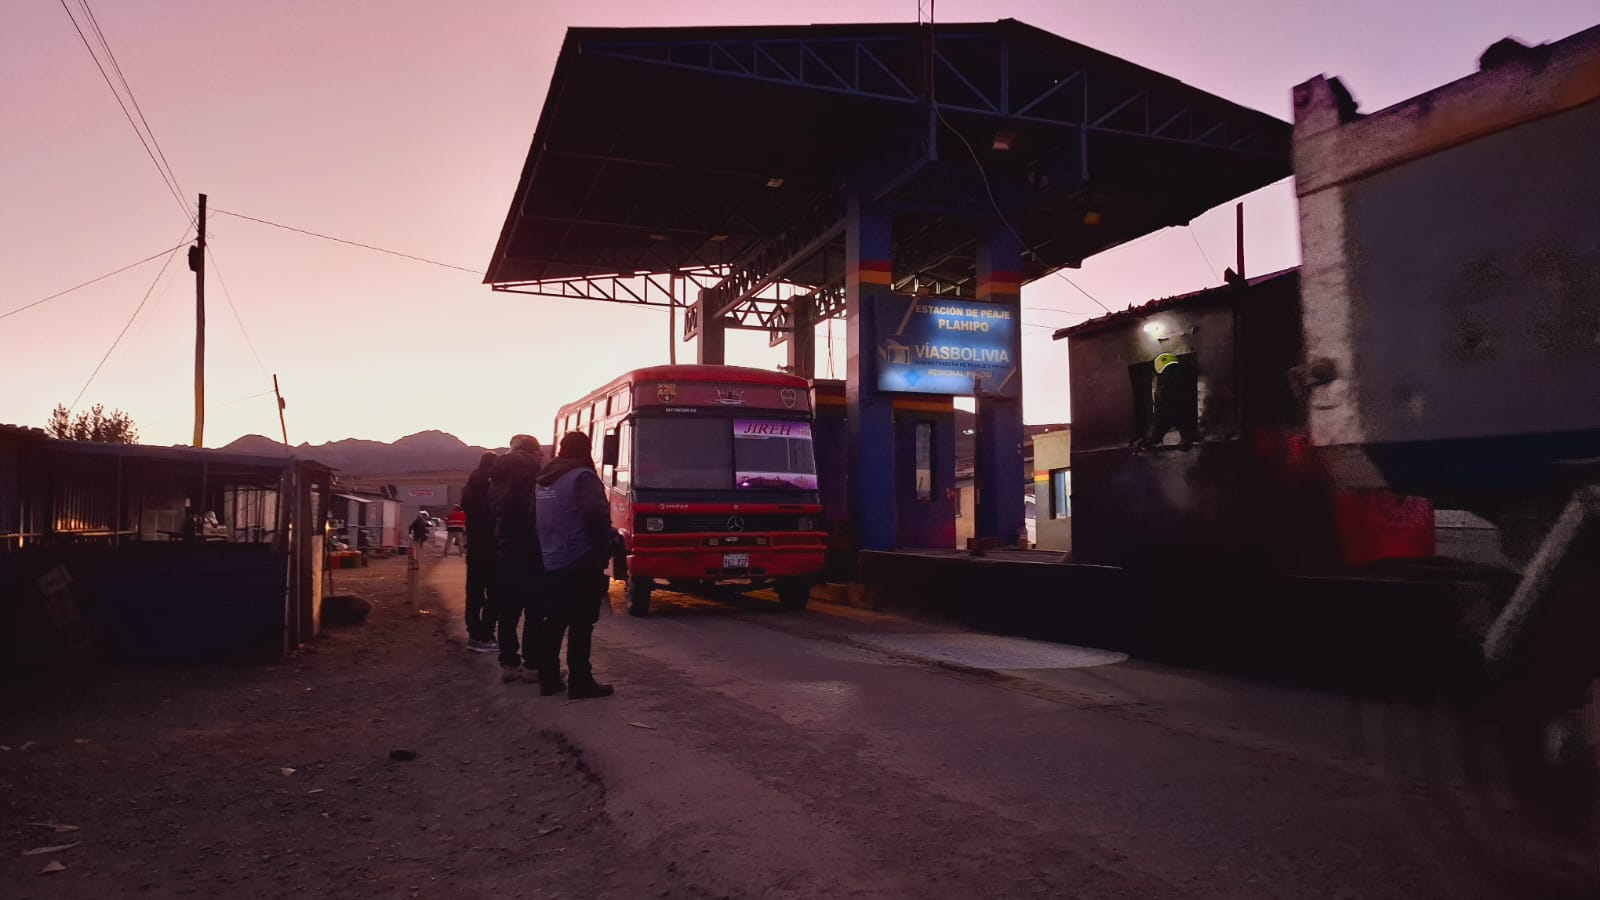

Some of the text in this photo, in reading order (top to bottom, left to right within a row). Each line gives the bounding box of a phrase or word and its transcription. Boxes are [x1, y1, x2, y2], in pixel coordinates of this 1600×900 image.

[915, 304, 1010, 319] ESTACIÓN DE PEAJE
[938, 319, 989, 332] PLAHIPO
[915, 342, 1009, 362] VÍASBOLIVIA
[743, 423, 792, 436] JIREH
